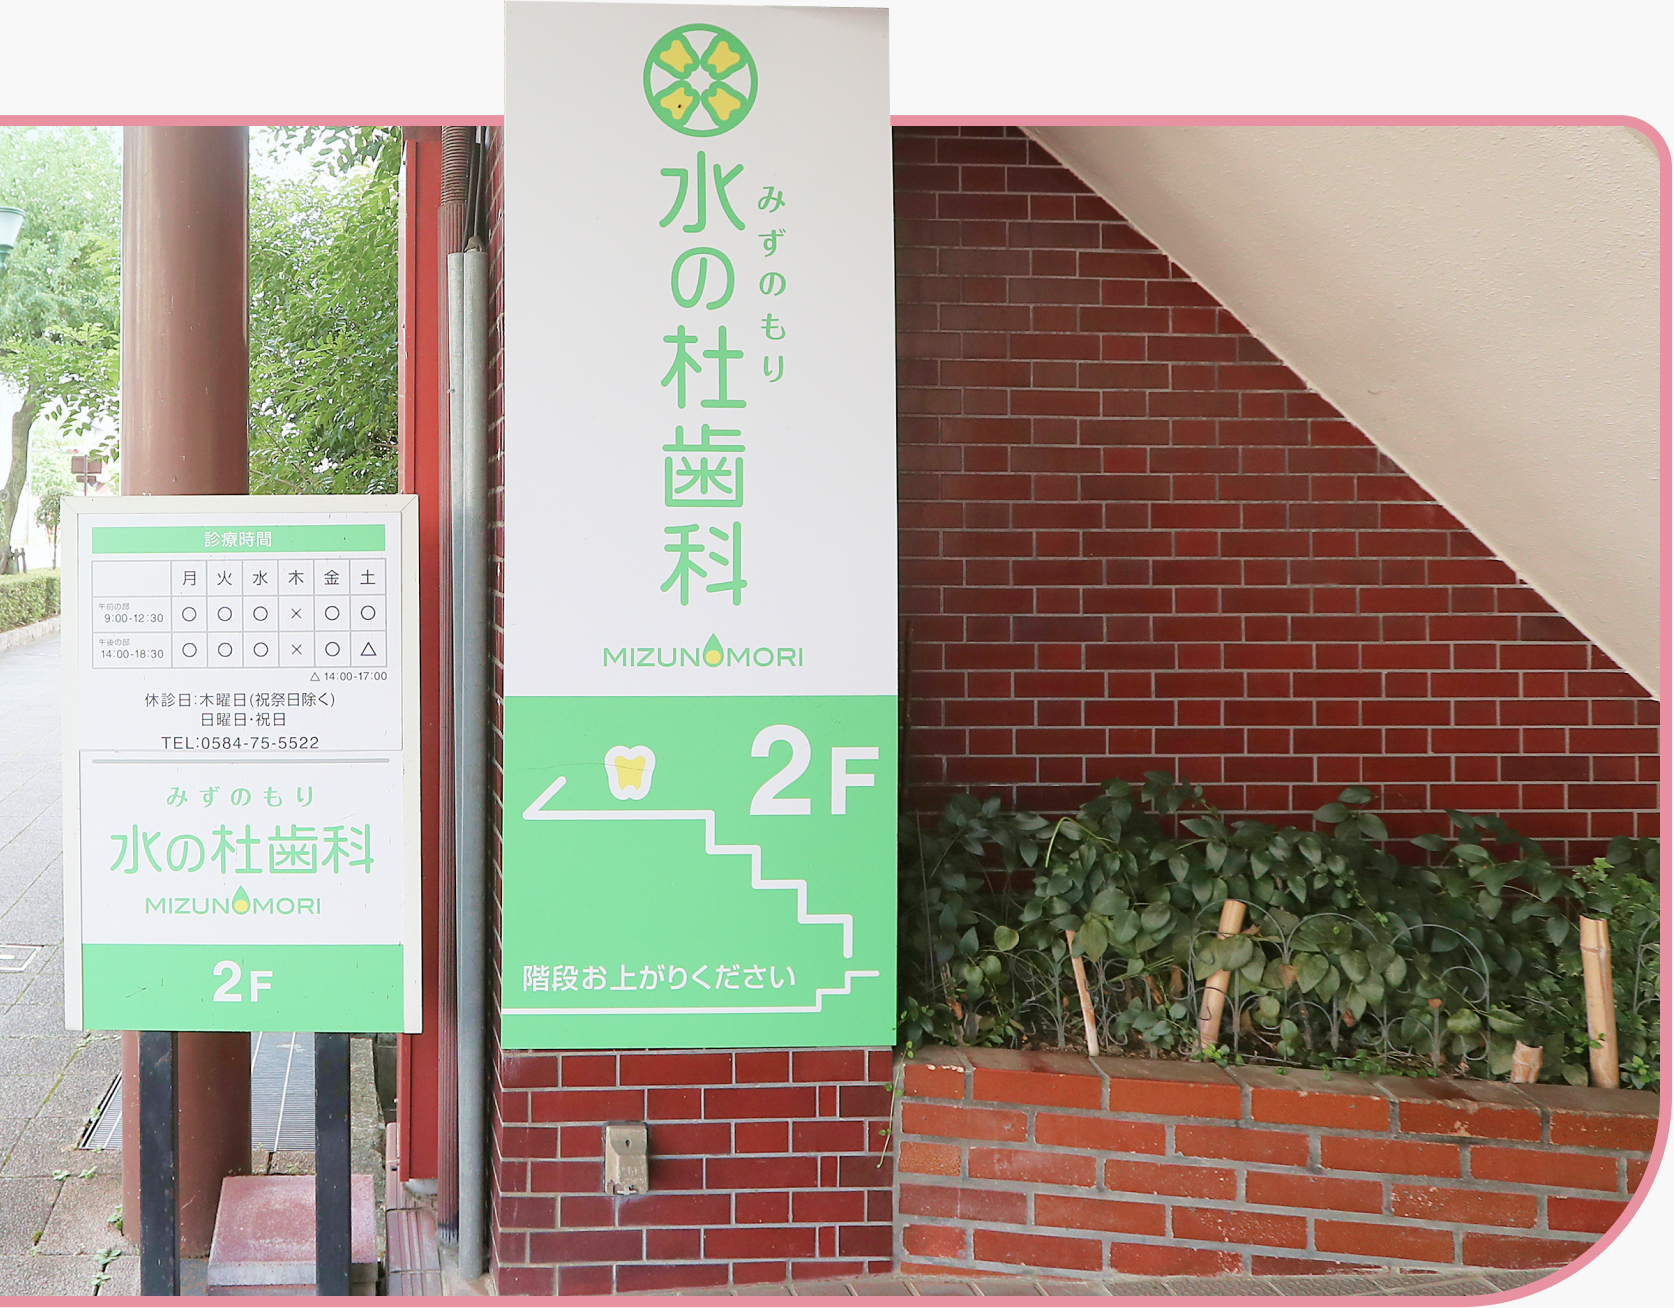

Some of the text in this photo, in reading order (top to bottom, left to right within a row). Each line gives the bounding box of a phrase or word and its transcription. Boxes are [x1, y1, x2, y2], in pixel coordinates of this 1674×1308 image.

[757, 185, 787, 383] みずのもり
[659, 150, 748, 607] 水の杜歯科
[204, 530, 272, 548] 診療時間
[182, 569, 376, 587] 月 火 水 木 金 土
[98, 602, 130, 611] 午前の部
[104, 613, 164, 623] 9:00-12:30
[101, 649, 164, 659] 14:00-18:30
[324, 671, 388, 682] 14:00-17:00
[161, 736, 319, 749] TEL:0584-75-5522
[749, 724, 880, 816] 2F
[166, 785, 313, 808] みずのもり
[109, 823, 375, 875] 水の杜歯科
[212, 959, 274, 1003] 2F
[522, 963, 797, 992] 階段お上がりください
